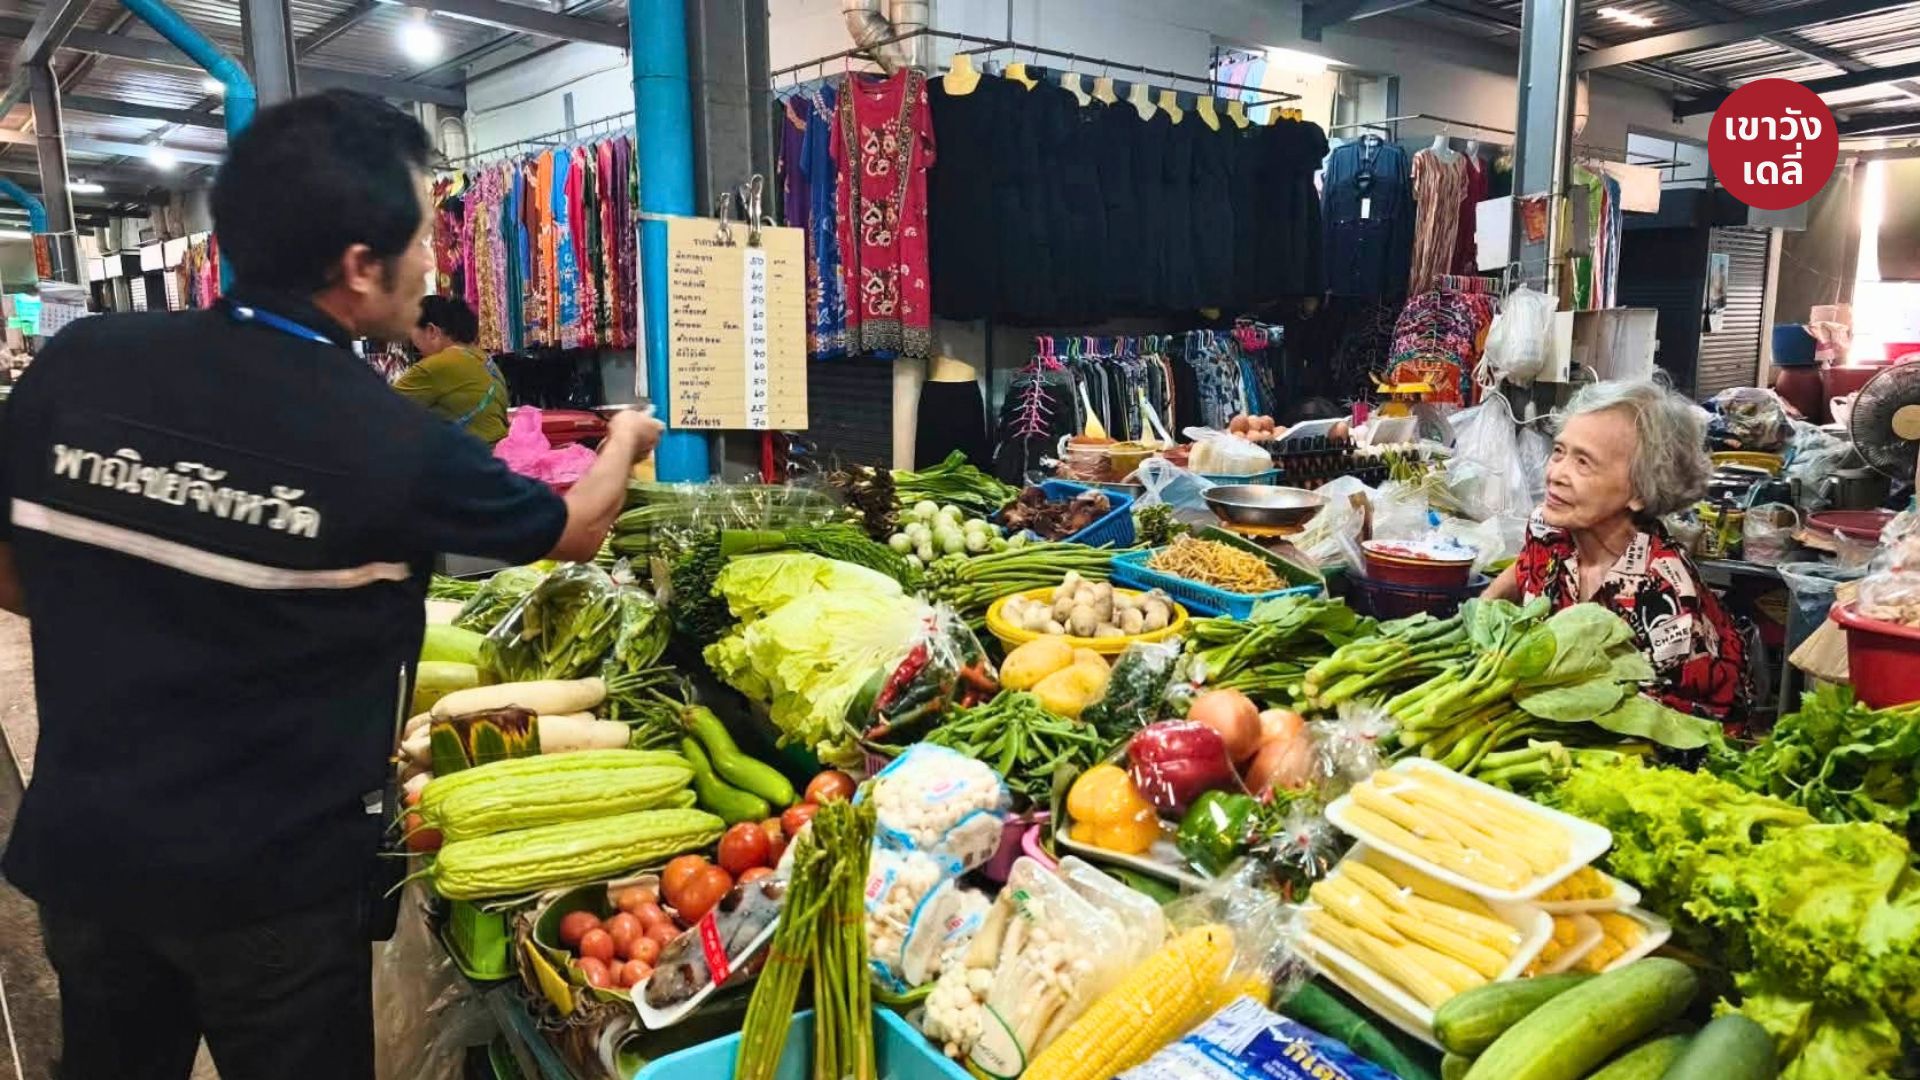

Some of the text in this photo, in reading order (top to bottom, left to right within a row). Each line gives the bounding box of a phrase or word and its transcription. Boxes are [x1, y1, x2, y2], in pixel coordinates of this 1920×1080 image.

[53, 443, 322, 539] พาณิชย์จังหวัด
